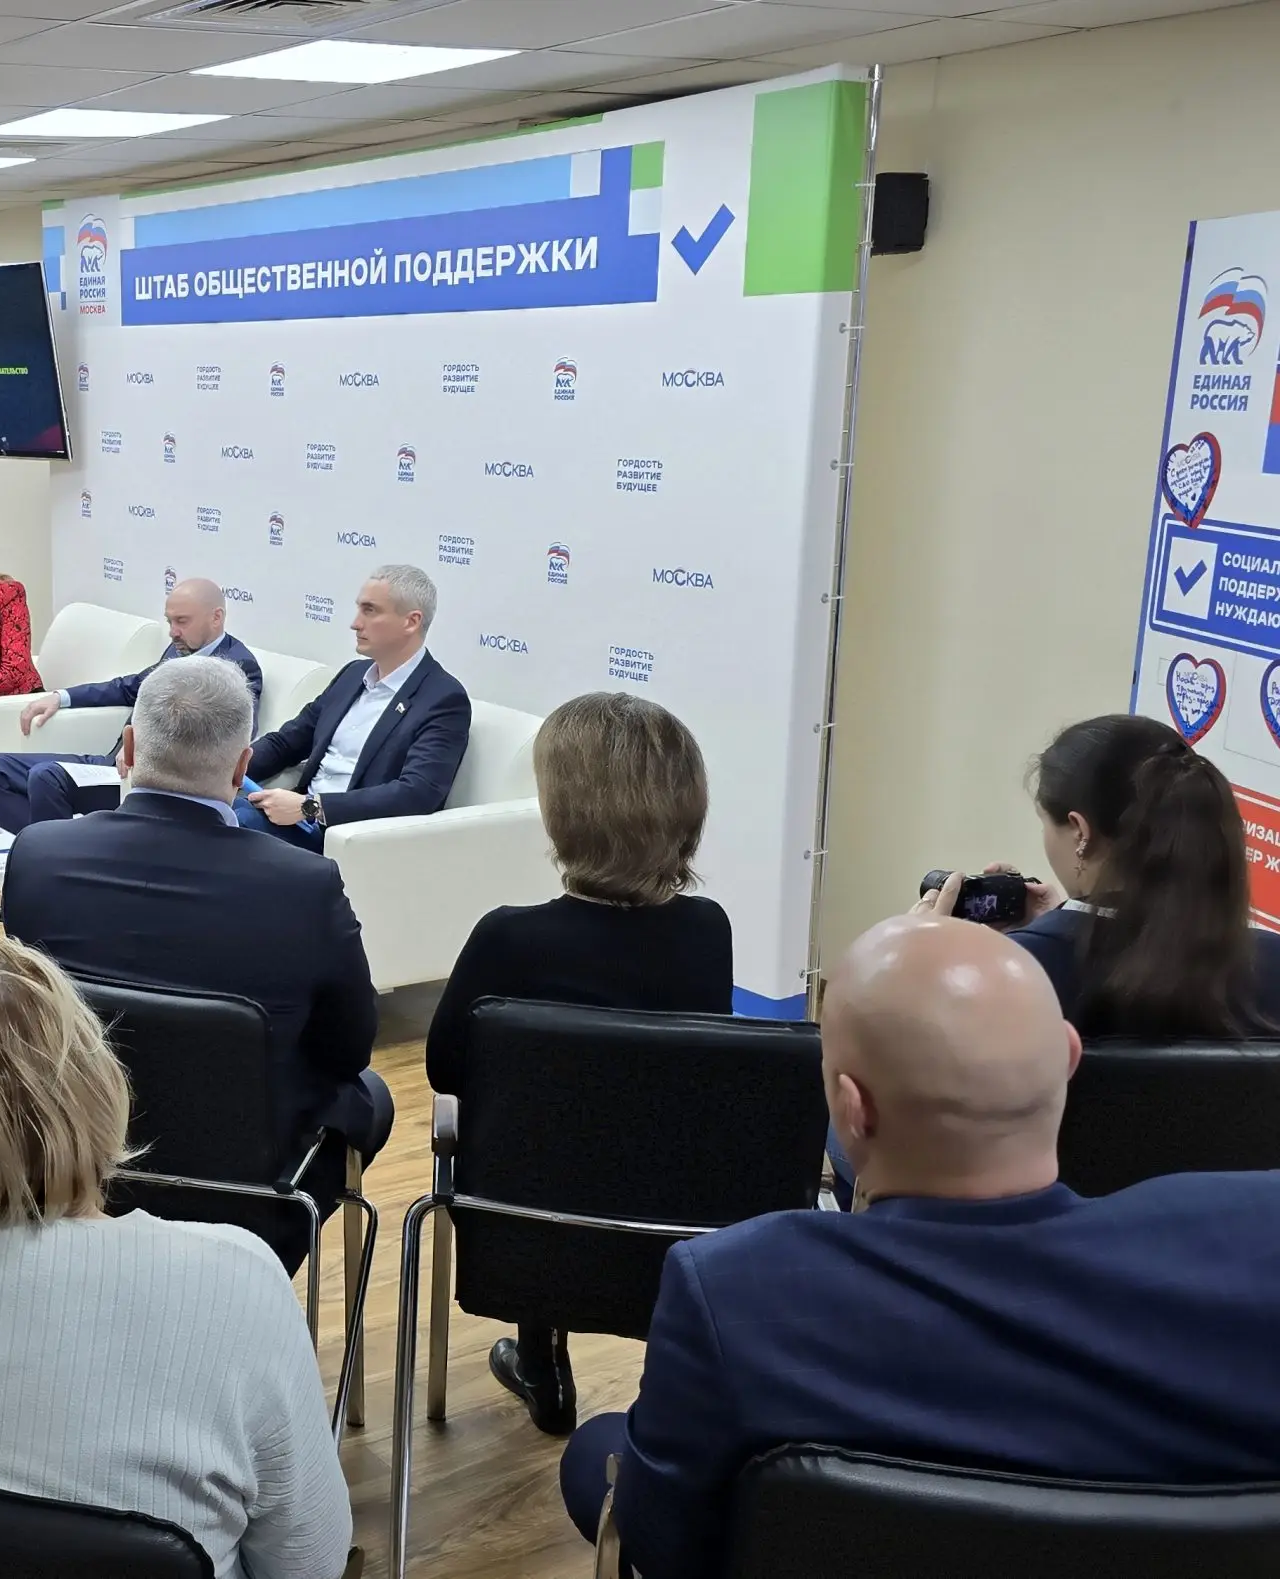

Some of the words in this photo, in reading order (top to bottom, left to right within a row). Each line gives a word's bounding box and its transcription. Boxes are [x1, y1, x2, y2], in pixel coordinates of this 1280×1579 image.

[134, 273, 190, 301] ШТАБ
[195, 248, 387, 299] ОБЩЕСТВЕННОЙ
[394, 236, 599, 286] ПОДДЕРЖКИ
[79, 275, 106, 287] ЕДИНАЯ
[79, 288, 106, 299] РОССИЯ
[79, 305, 106, 315] МОСКВА
[443, 364, 479, 372] ГОРДОСТЬ
[339, 372, 379, 387] МОСКВА
[662, 368, 724, 388] МОСКВА
[1192, 374, 1252, 392] ЕДИНАЯ
[443, 385, 475, 393] БУДУЩЕЕ
[1190, 393, 1249, 412] РОССИЯ
[221, 446, 255, 460] МОСКВА
[484, 462, 534, 477] МОСКВА
[617, 458, 663, 469] ГОРДОСТЬ
[617, 470, 662, 480] РАЗВИТИЕ
[616, 481, 657, 492] БУДУЩЕЕ
[337, 532, 376, 548] МОСКВА
[439, 534, 475, 546] ГОРДОСТЬ
[439, 544, 474, 555] РАЗВИТИЕ
[439, 555, 470, 565] БУДУЩЕЕ
[653, 567, 714, 589] МОСКВА
[222, 587, 254, 604] МОСКВА
[305, 594, 334, 606] ГОРДОСТЬ
[305, 603, 334, 614] РАЗВИТИЕ
[479, 634, 528, 654] МОСКВА
[609, 646, 654, 661] ГОРДОСТЬ
[609, 657, 653, 672] РАЗВИТИЕ
[608, 668, 649, 682] БУДУЩЕЕ
